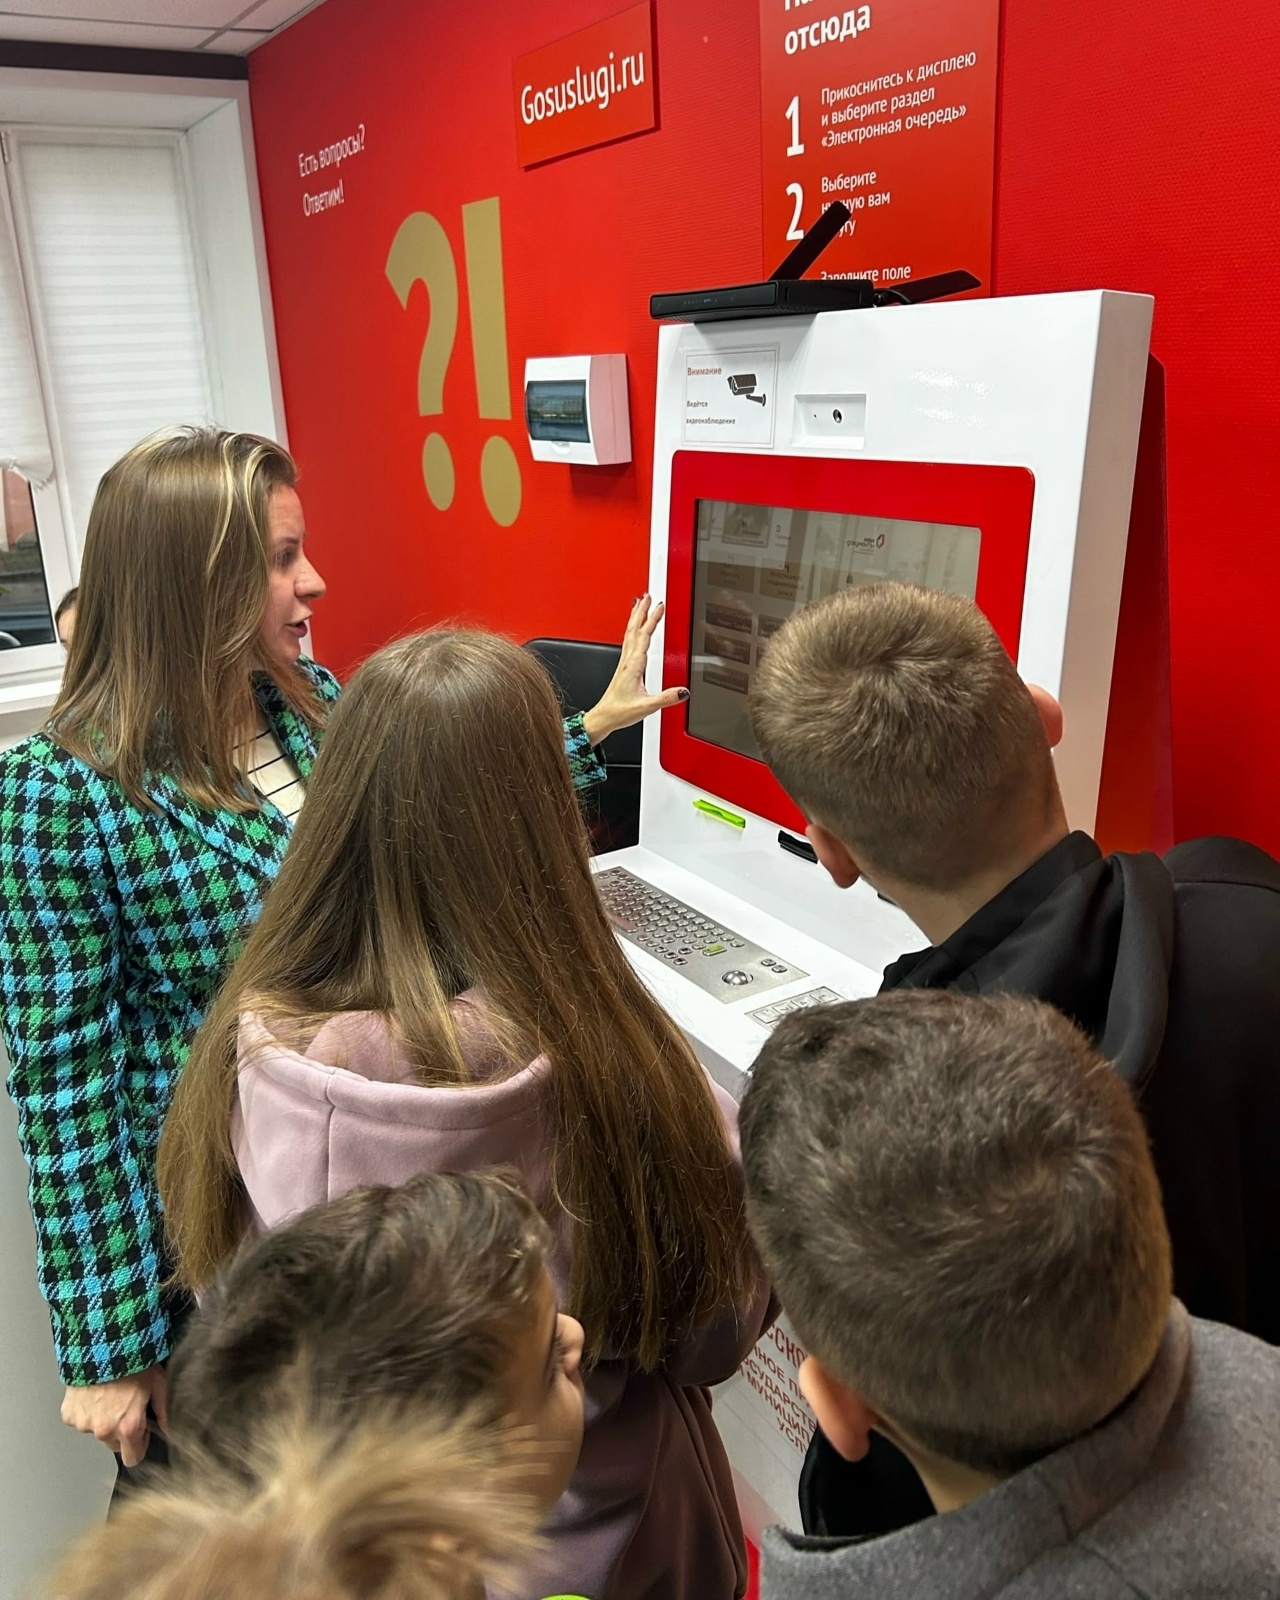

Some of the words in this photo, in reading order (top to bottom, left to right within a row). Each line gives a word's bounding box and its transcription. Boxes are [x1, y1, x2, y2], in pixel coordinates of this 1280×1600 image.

[784, 4, 871, 55] отсюда
[520, 51, 645, 125] Gosuslugi.ru
[821, 72, 904, 107] Прикоснитесь
[906, 68, 914, 83] к
[916, 51, 977, 83] дисплею
[785, 95, 805, 157] 1
[821, 114, 829, 127] и
[831, 99, 888, 122] выберите
[890, 87, 936, 114] раздел
[821, 118, 902, 147] «Электронная
[905, 104, 967, 130] очередь»
[298, 153, 319, 178] Есть
[319, 123, 366, 168] вопросы?
[302, 178, 345, 217] Ответим!
[821, 171, 877, 193] Выберите
[867, 191, 891, 208] вам
[785, 182, 805, 241] 2
[882, 265, 912, 281] поле
[687, 367, 723, 377] Внимание
[685, 417, 736, 426] видеонаблюдение
